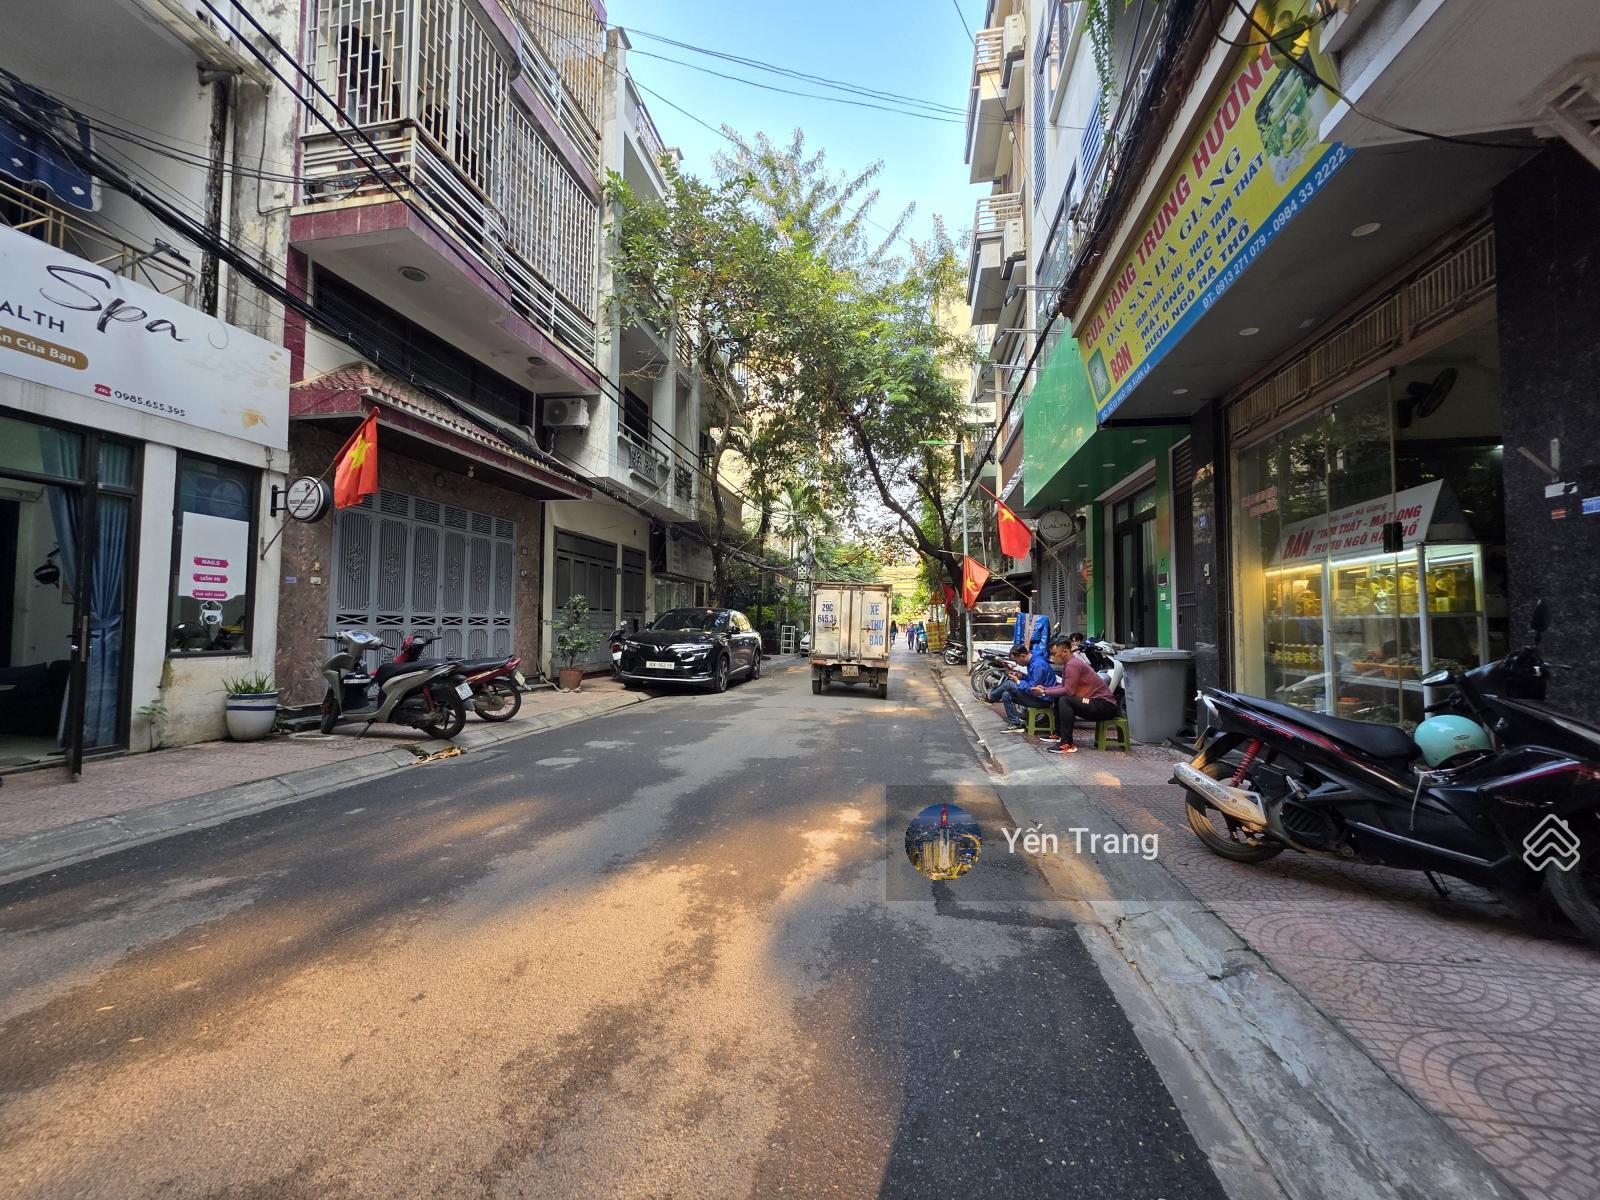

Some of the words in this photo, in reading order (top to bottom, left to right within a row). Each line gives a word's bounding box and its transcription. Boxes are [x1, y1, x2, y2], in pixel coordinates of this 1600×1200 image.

[1135, 172, 1192, 266] TRUNG
[1154, 242, 1177, 277] HÀ
[1179, 146, 1241, 241] GIANG
[1215, 270, 1235, 296] 0913
[1233, 253, 1250, 275] 271
[1249, 234, 1267, 257] 079
[1272, 199, 1299, 233] 0984
[1298, 182, 1315, 204] 33
[1314, 147, 1348, 187] 2222
[1134, 308, 1149, 329] TAM
[1170, 261, 1183, 283] NỤ
[1189, 229, 1209, 257] HOA
[1209, 195, 1233, 229] TAM
[1232, 151, 1264, 197] THẤT
[1161, 280, 1186, 313] ONG
[1186, 245, 1214, 283] BẠC
[1215, 214, 1239, 246] HÀ
[39, 264, 190, 342] Spa
[1170, 286, 1196, 321] NGÔ
[16, 337, 46, 354] Của
[49, 347, 77, 364] Bạn
[113, 390, 186, 417] 0985.655.395
[1395, 504, 1423, 521] ONG
[821, 603, 834, 612] 29C
[870, 604, 880, 616] XE
